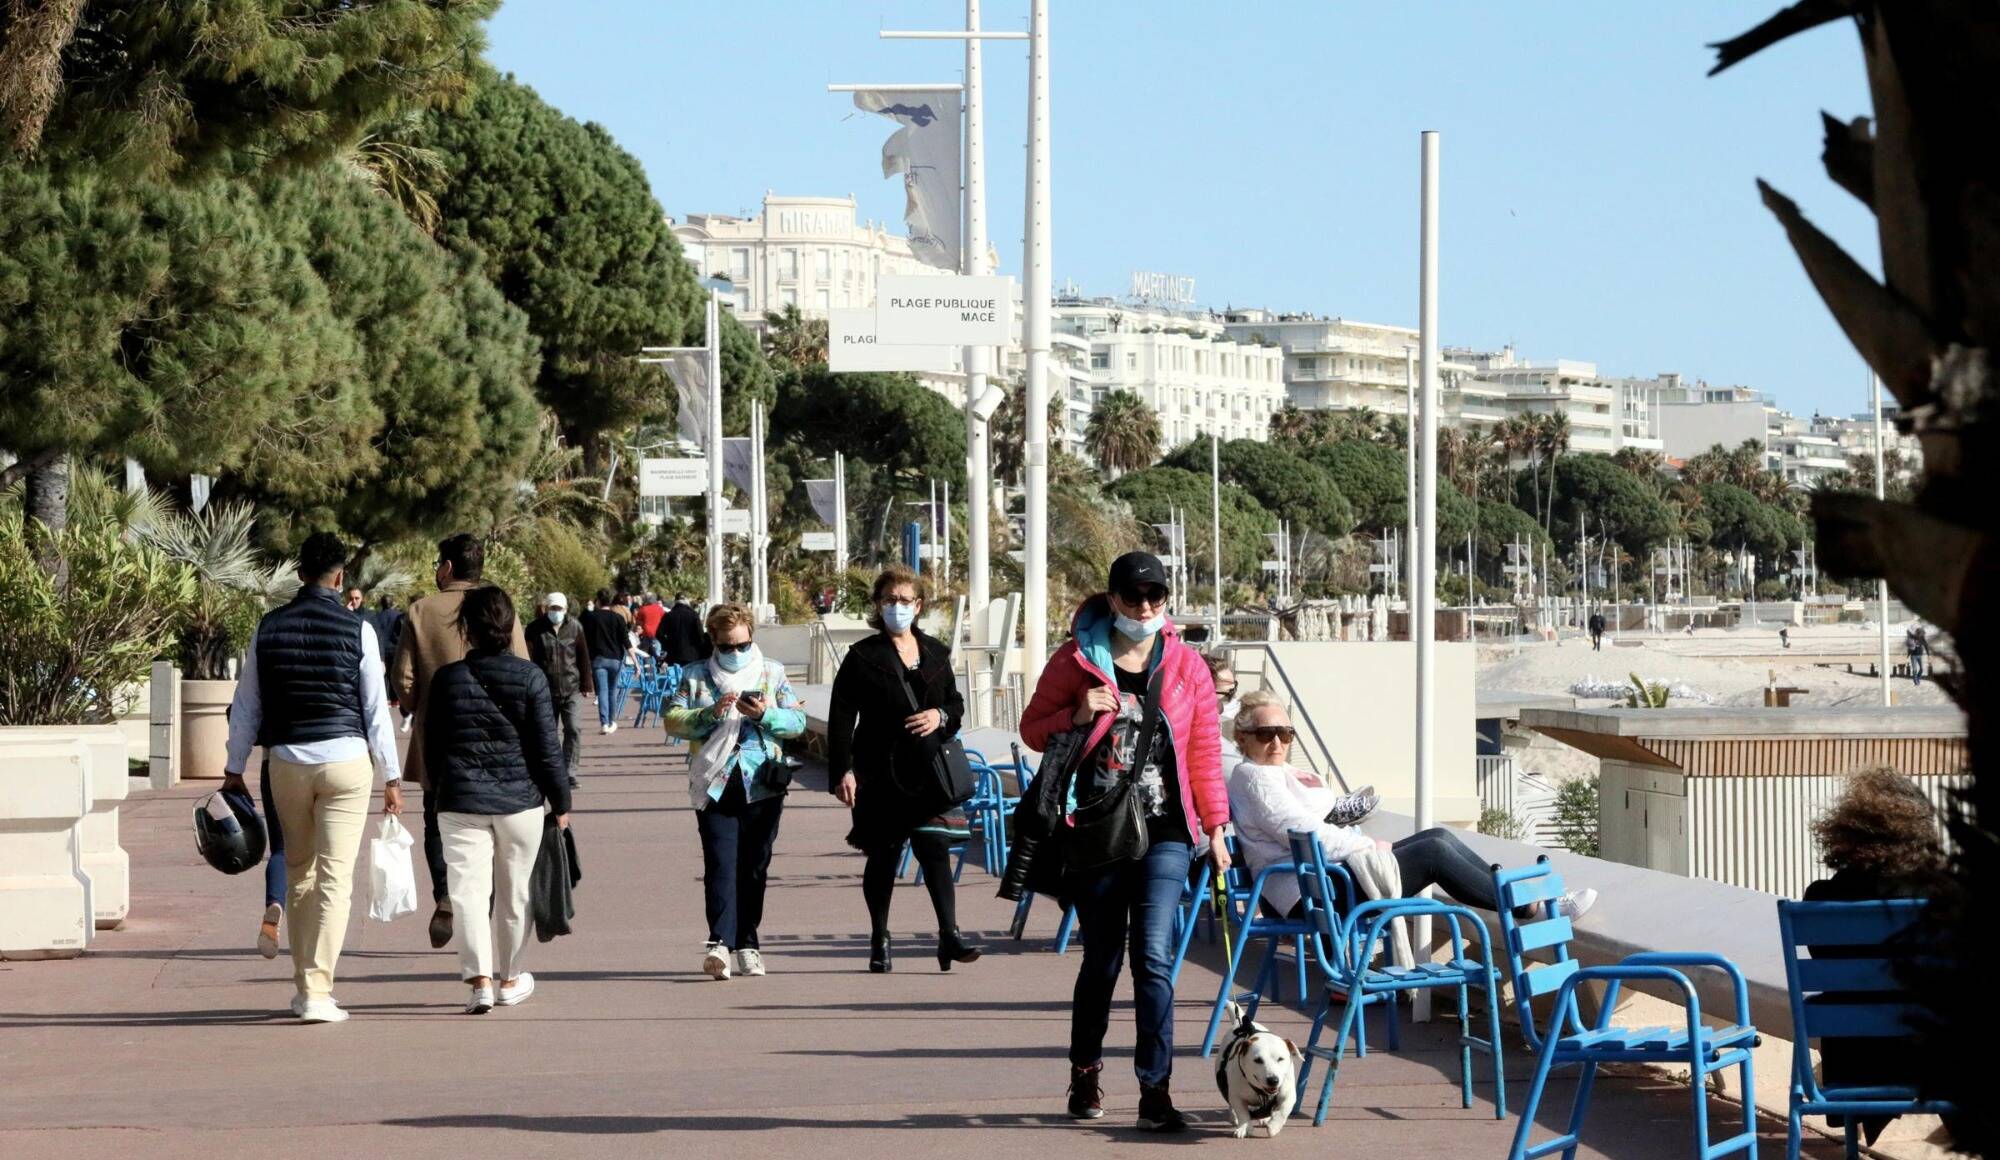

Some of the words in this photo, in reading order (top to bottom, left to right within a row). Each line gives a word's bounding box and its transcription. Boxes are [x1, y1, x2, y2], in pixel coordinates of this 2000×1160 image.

[1134, 272, 1196, 303] MARTINEZ
[890, 298, 931, 309] PLAGE
[935, 299, 996, 309] PUBLIQUE
[843, 335, 877, 344] PLAG
